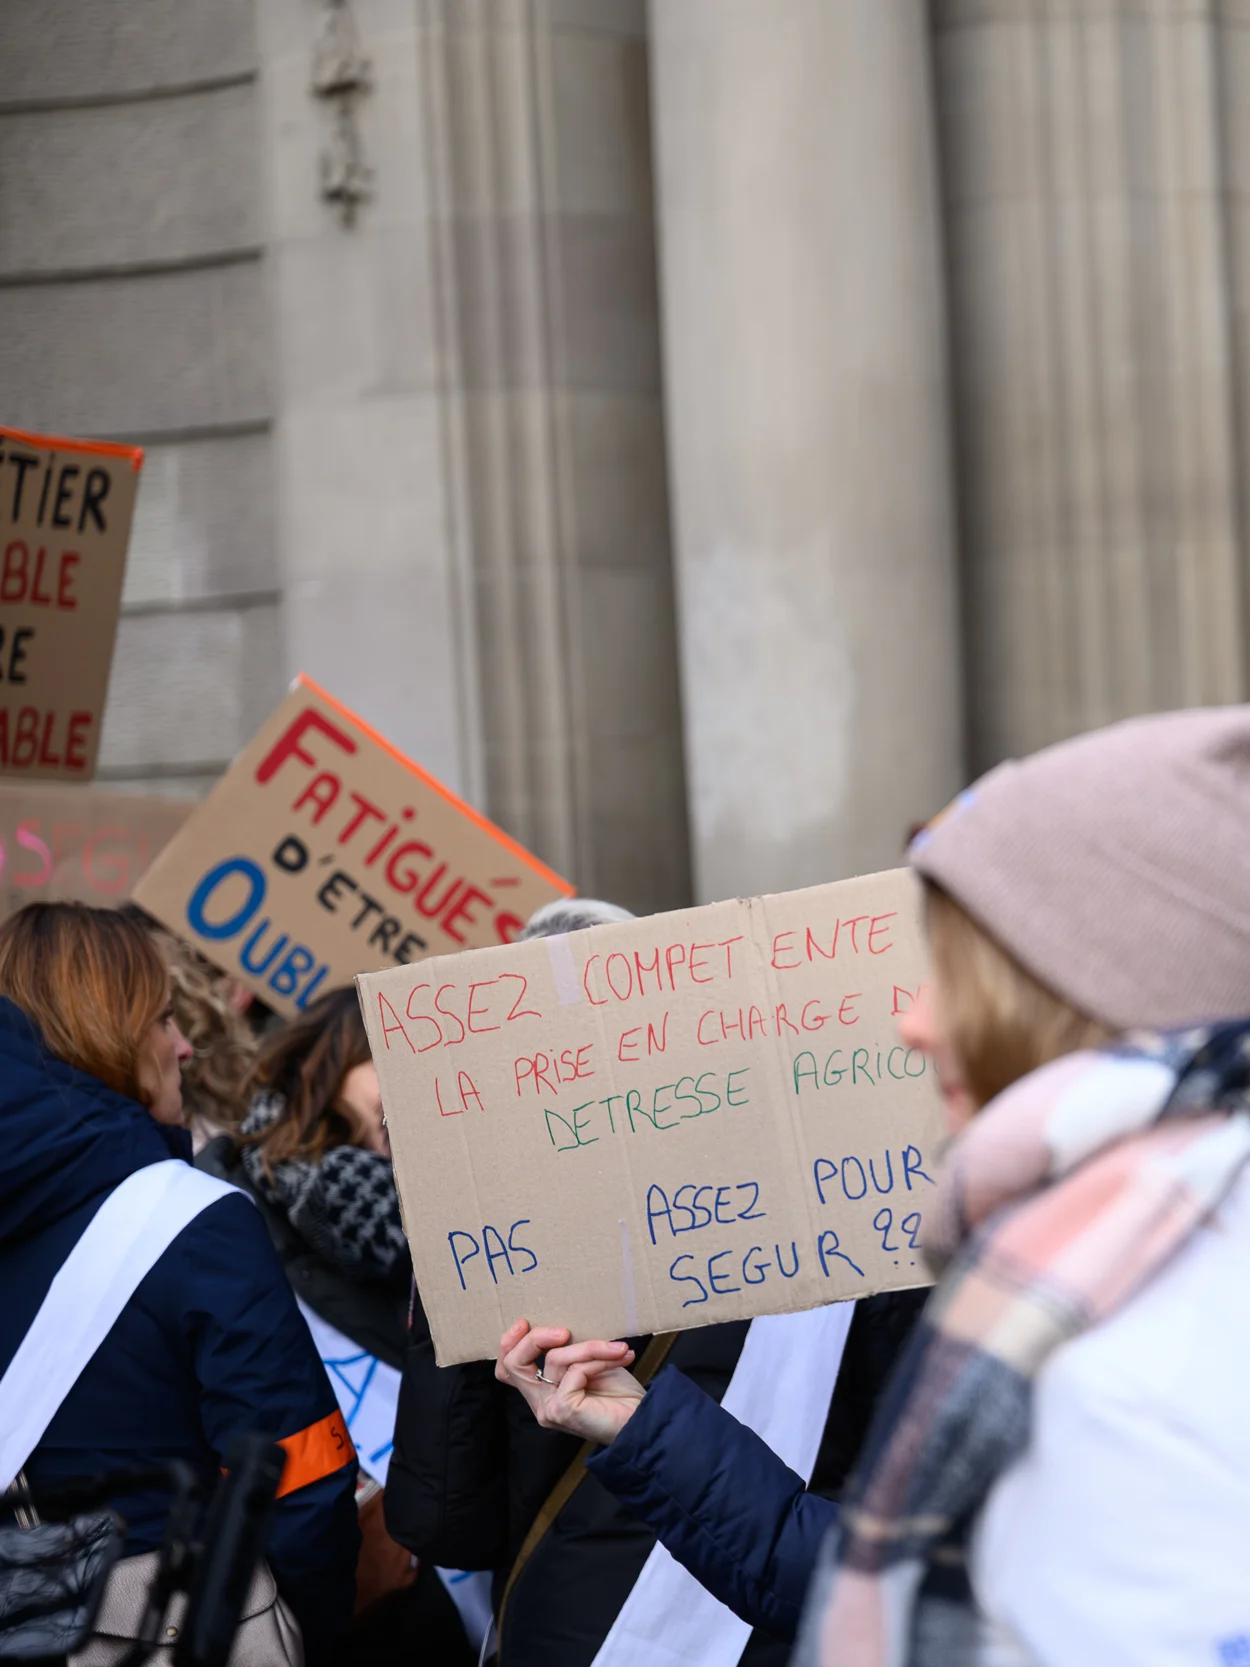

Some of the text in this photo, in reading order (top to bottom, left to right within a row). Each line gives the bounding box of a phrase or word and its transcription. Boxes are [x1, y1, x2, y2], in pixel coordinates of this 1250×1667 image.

[0, 440, 111, 534] TIER
[0, 627, 34, 685] E
[376, 973, 542, 1055] ASSEZ
[434, 1069, 485, 1117] LA
[617, 1011, 669, 1063] EN
[697, 992, 862, 1046] CHARGE
[890, 984, 930, 1018] D
[543, 1045, 940, 1152] DETRESSE AGRICO
[447, 1144, 938, 1291] PAS ASSEZ POUR
[669, 1229, 866, 1308] SEGUR
